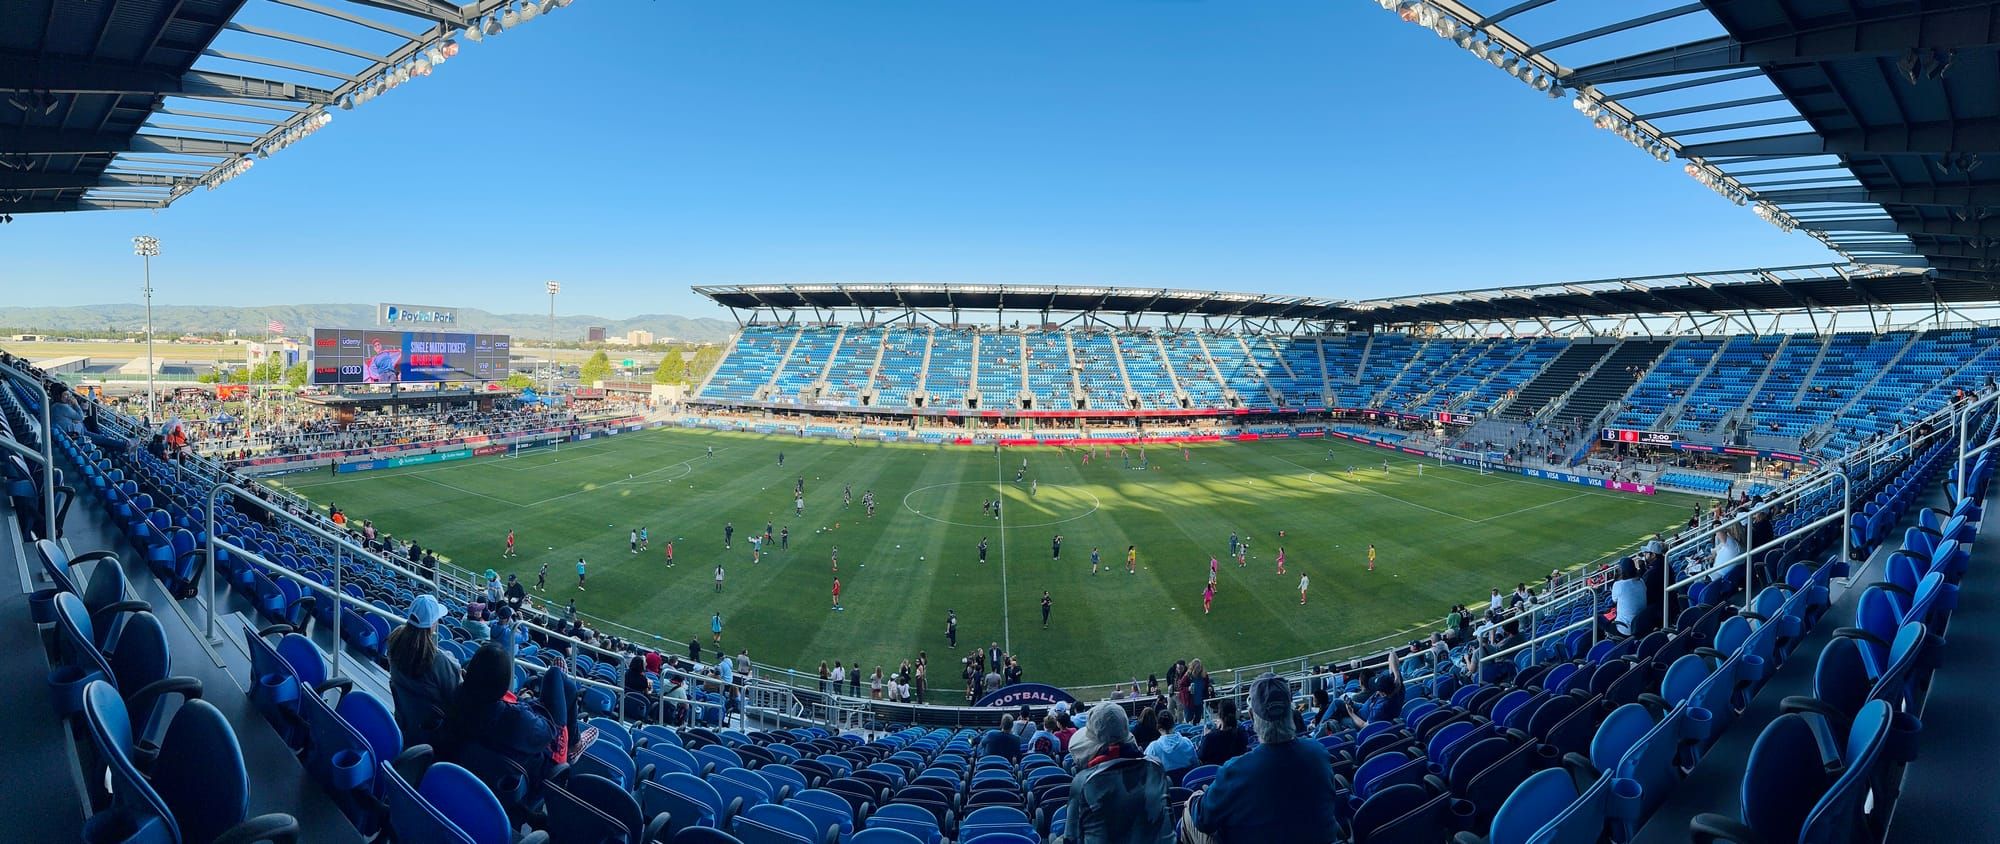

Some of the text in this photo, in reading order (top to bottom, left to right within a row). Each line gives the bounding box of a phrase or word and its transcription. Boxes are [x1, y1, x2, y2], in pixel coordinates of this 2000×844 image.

[399, 309, 432, 323] PayPal
[432, 311, 455, 323] Park
[410, 341, 429, 353] SINGLE
[429, 342, 447, 353] MATCH
[447, 342, 466, 354] TICKETS
[1648, 433, 1670, 441] 12:00
[1527, 469, 1602, 487] VISA VISA VISA VISA
